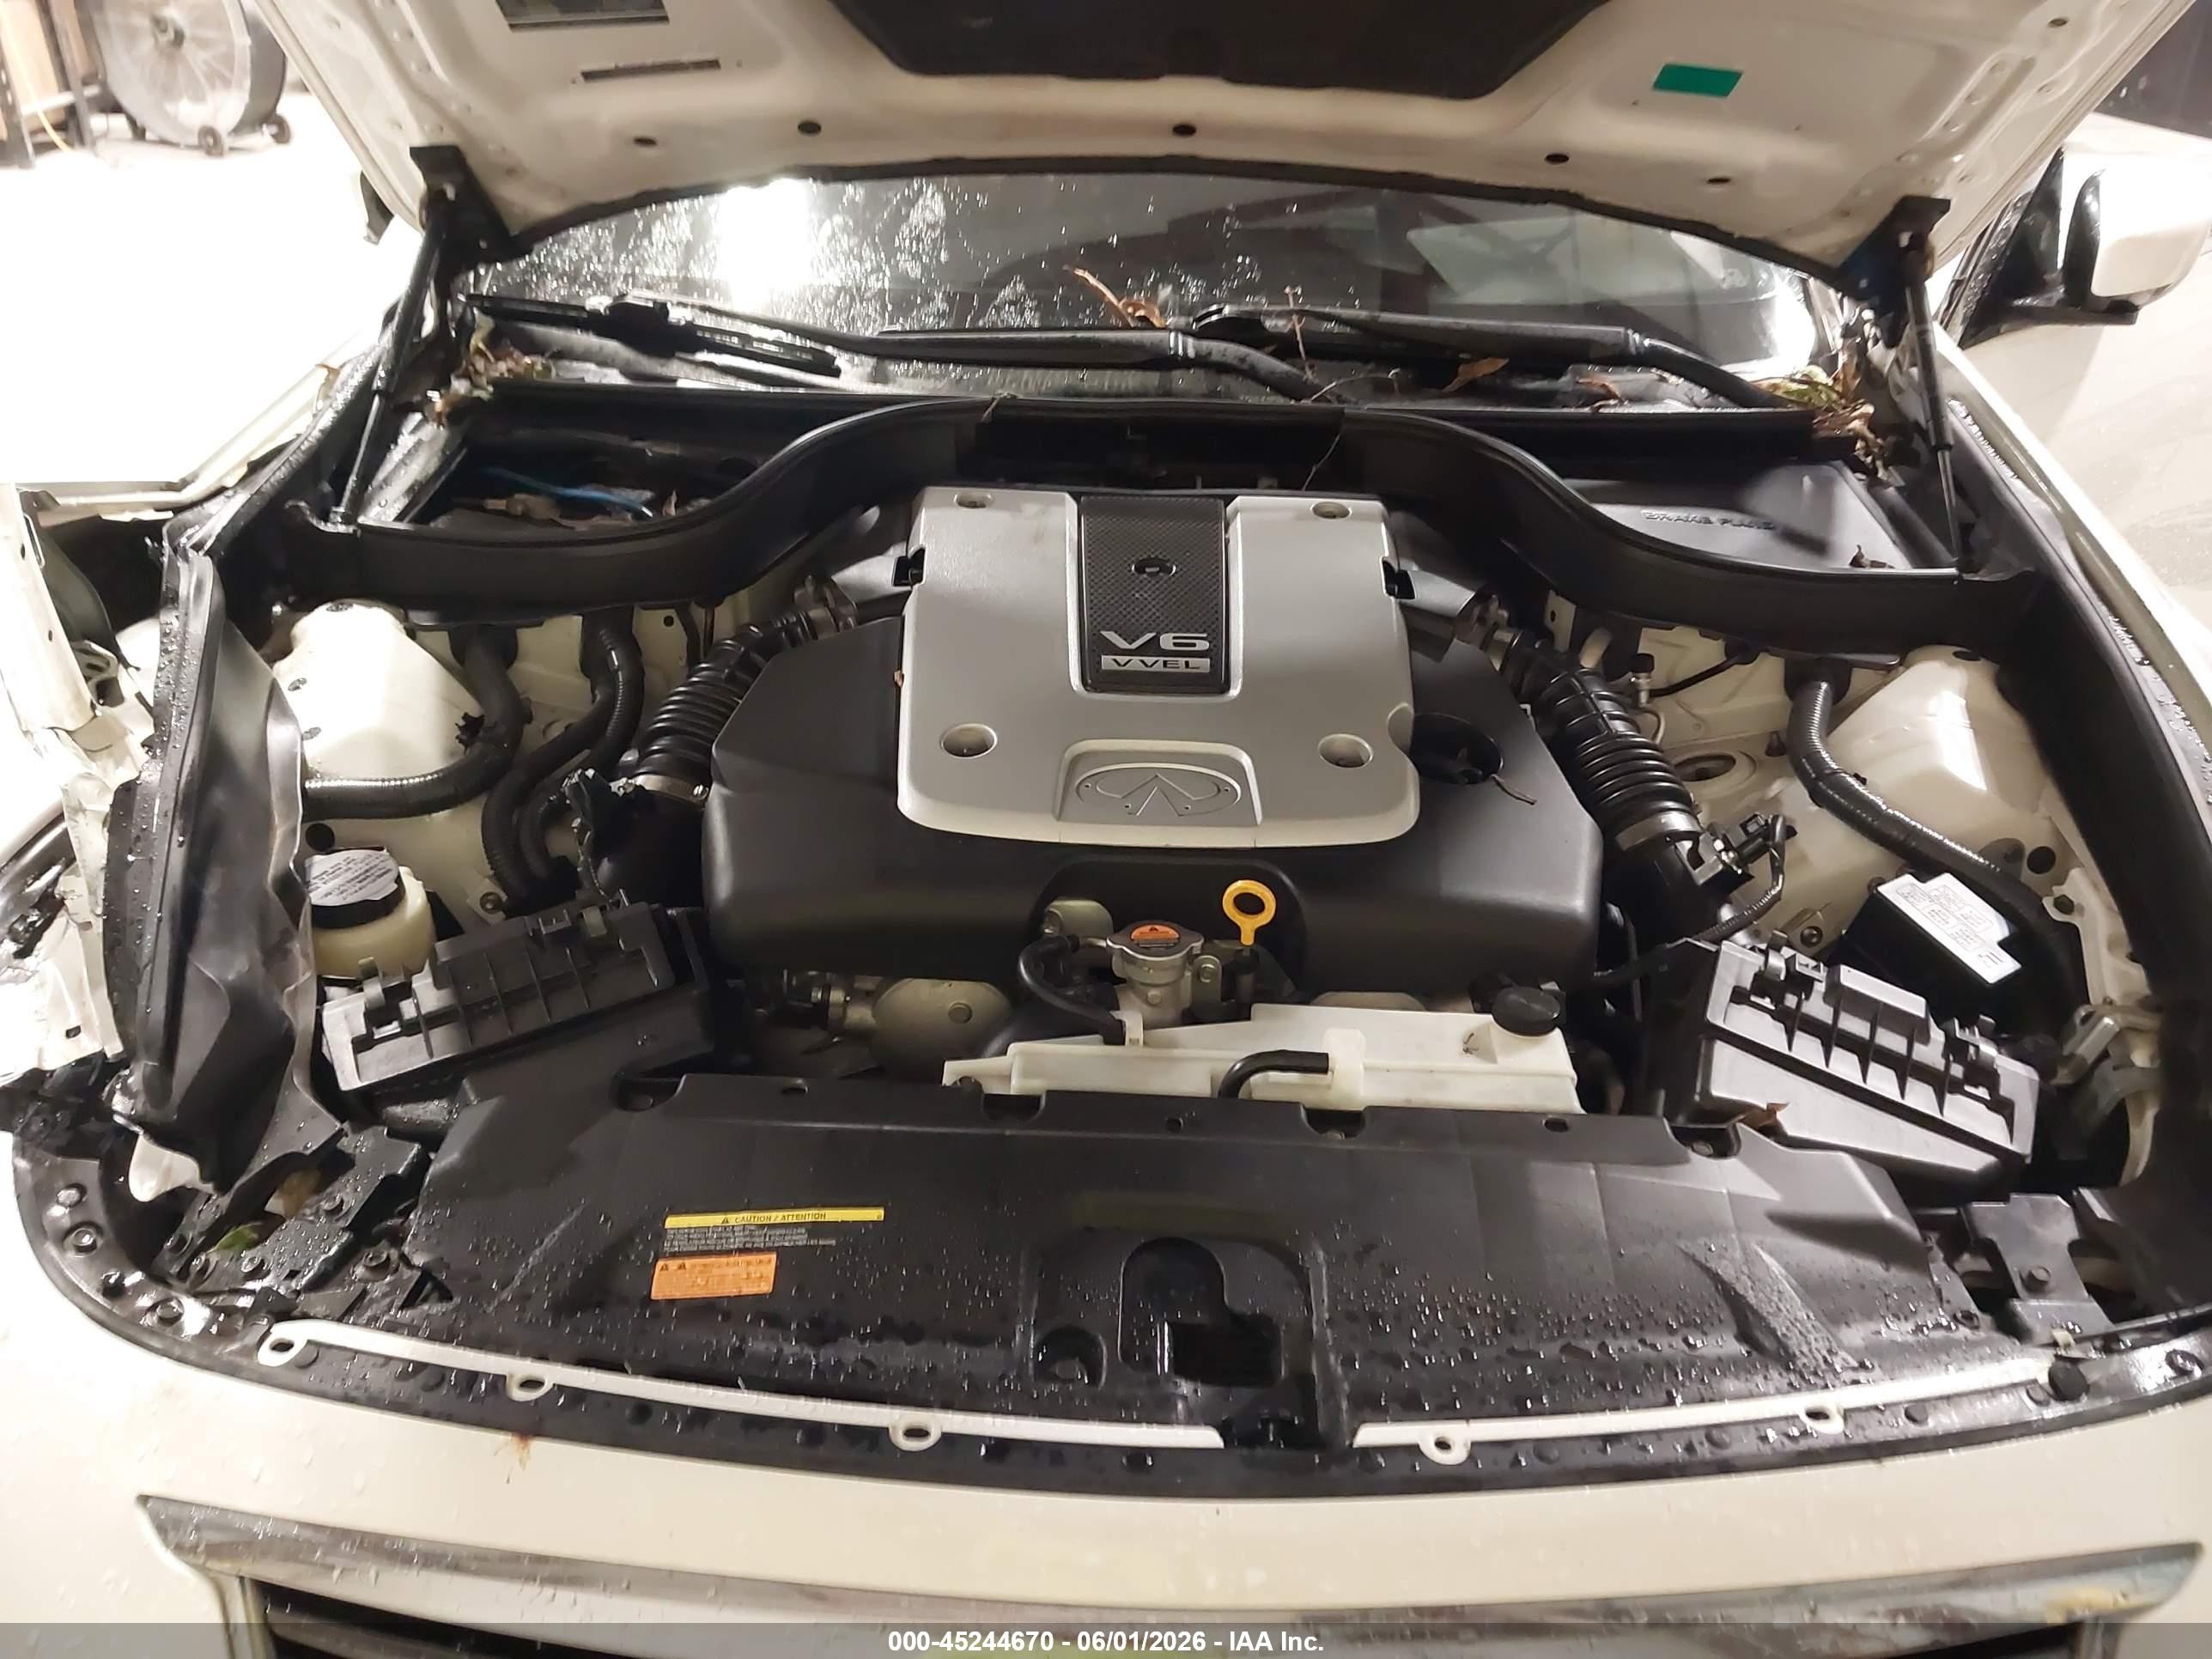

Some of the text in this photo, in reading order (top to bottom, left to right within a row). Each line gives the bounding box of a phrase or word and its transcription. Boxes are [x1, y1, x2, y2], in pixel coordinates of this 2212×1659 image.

[1099, 630, 1210, 652] V6
[1111, 658, 1201, 670] VVEL
[734, 1214, 773, 1224] CAUTION
[780, 1212, 826, 1222] ATTENTION
